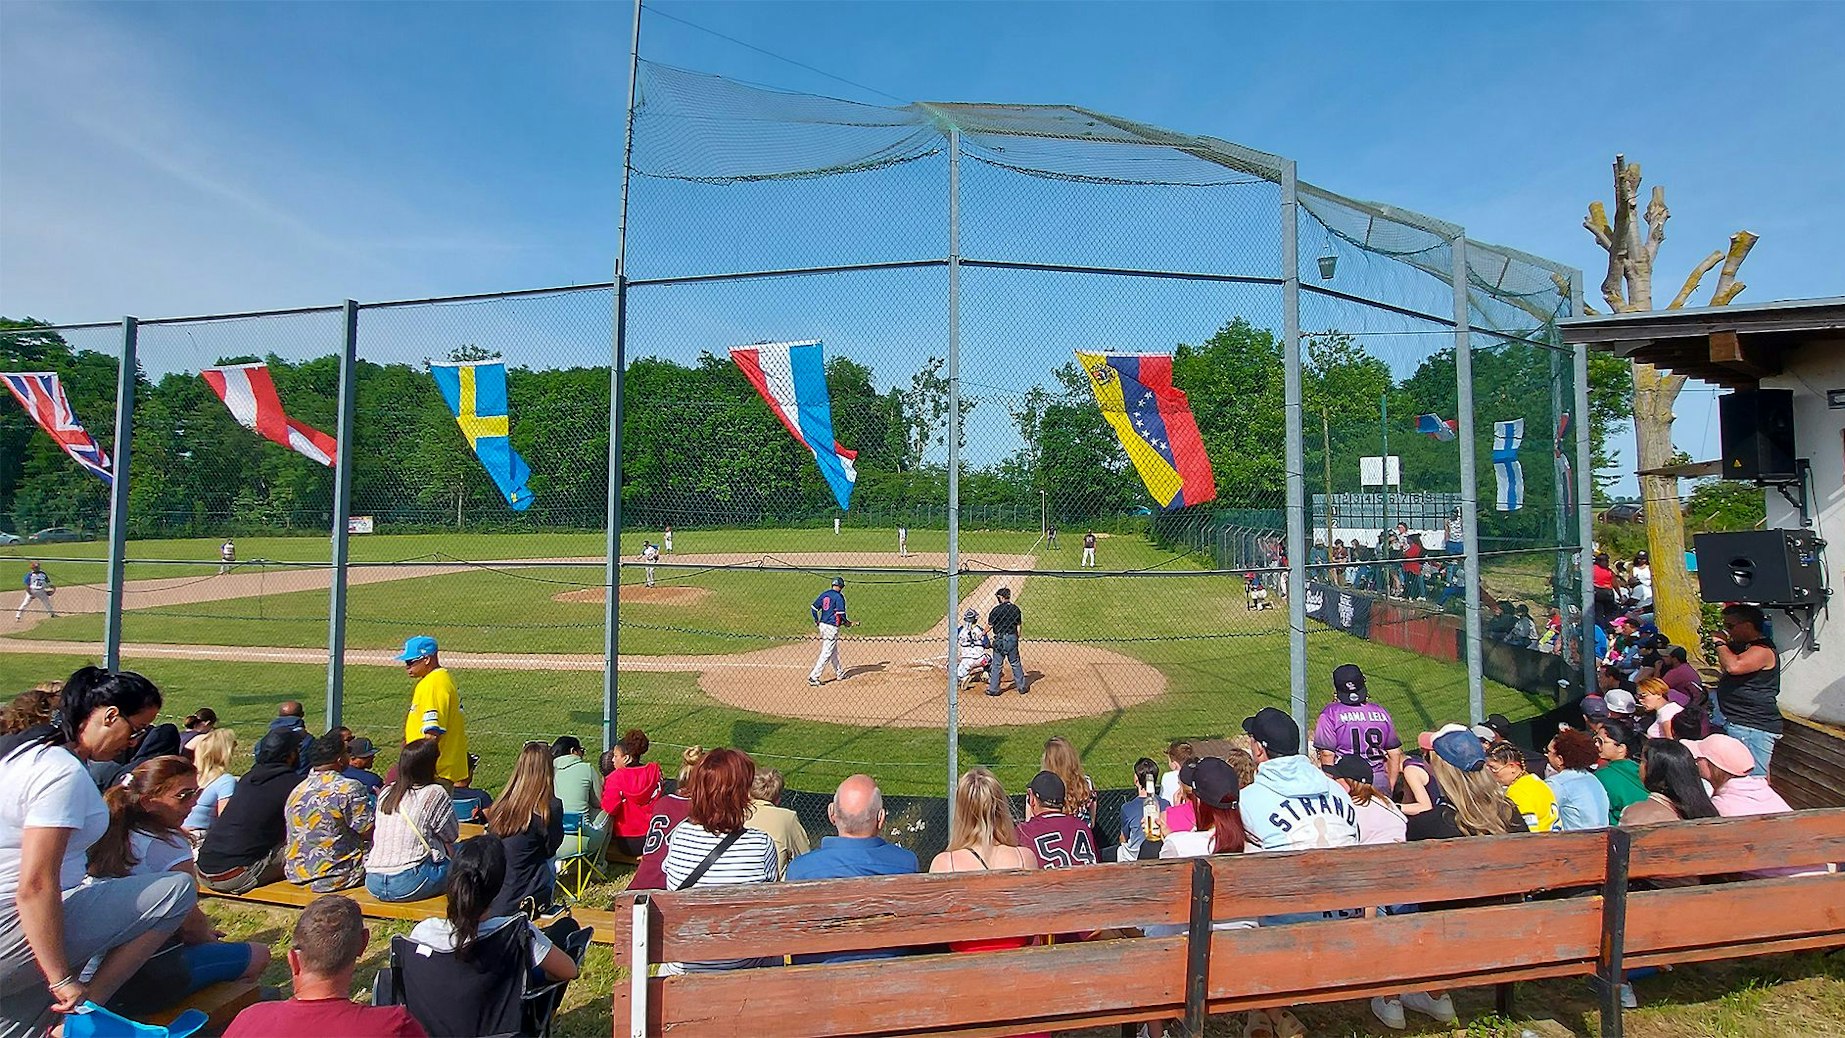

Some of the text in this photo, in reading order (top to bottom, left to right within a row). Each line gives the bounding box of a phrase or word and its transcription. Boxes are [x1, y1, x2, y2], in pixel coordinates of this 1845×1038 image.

[1350, 727, 1385, 761] 18
[1269, 793, 1356, 833] STRAND
[643, 814, 676, 855] 6
[1033, 829, 1097, 870] 54
